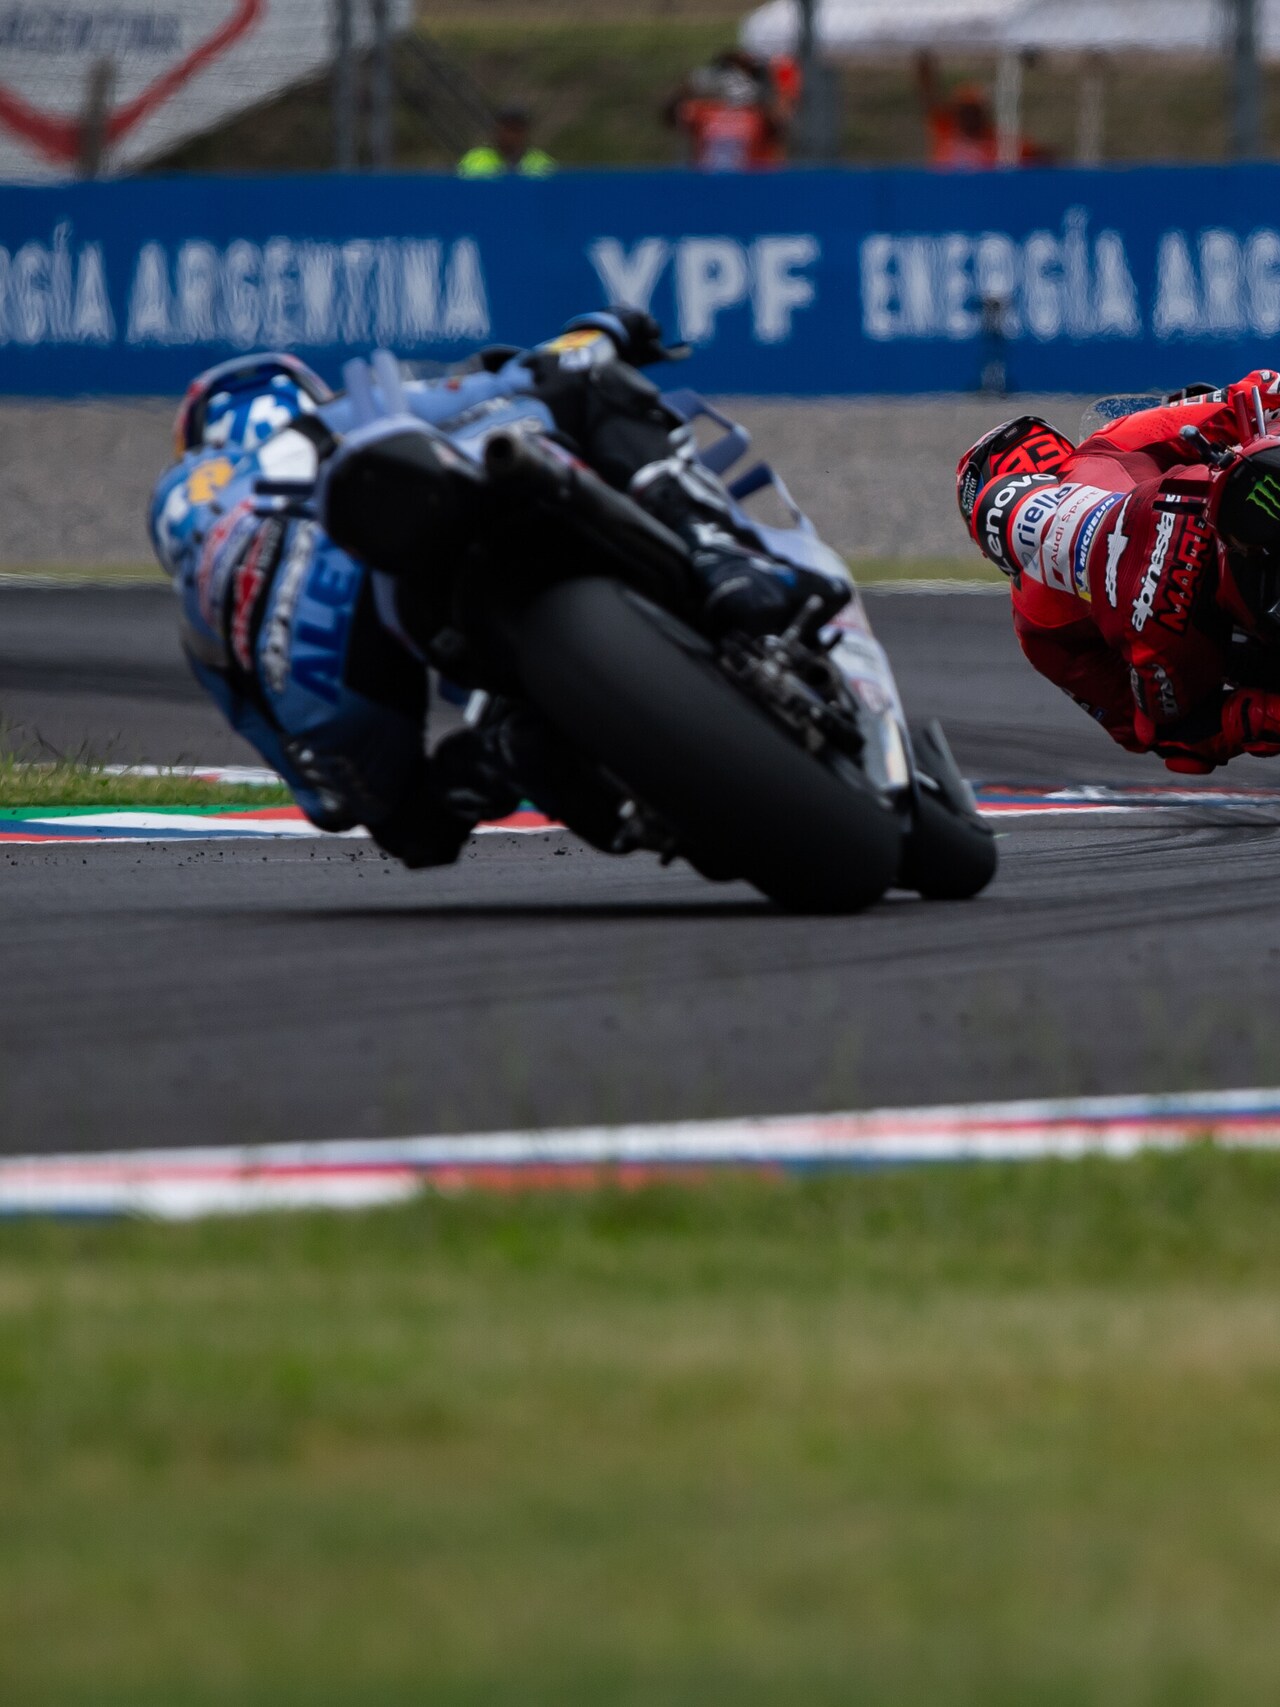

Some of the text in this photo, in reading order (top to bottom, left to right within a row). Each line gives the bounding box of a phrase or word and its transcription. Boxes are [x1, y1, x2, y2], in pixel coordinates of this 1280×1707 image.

[125, 239, 489, 345] ARGENTINA
[588, 234, 820, 341] YPF
[861, 208, 1139, 338] ENERGÍA
[1016, 486, 1073, 547] riello
[1050, 489, 1099, 567] Audi Sport
[1078, 496, 1116, 568] MICHELIN
